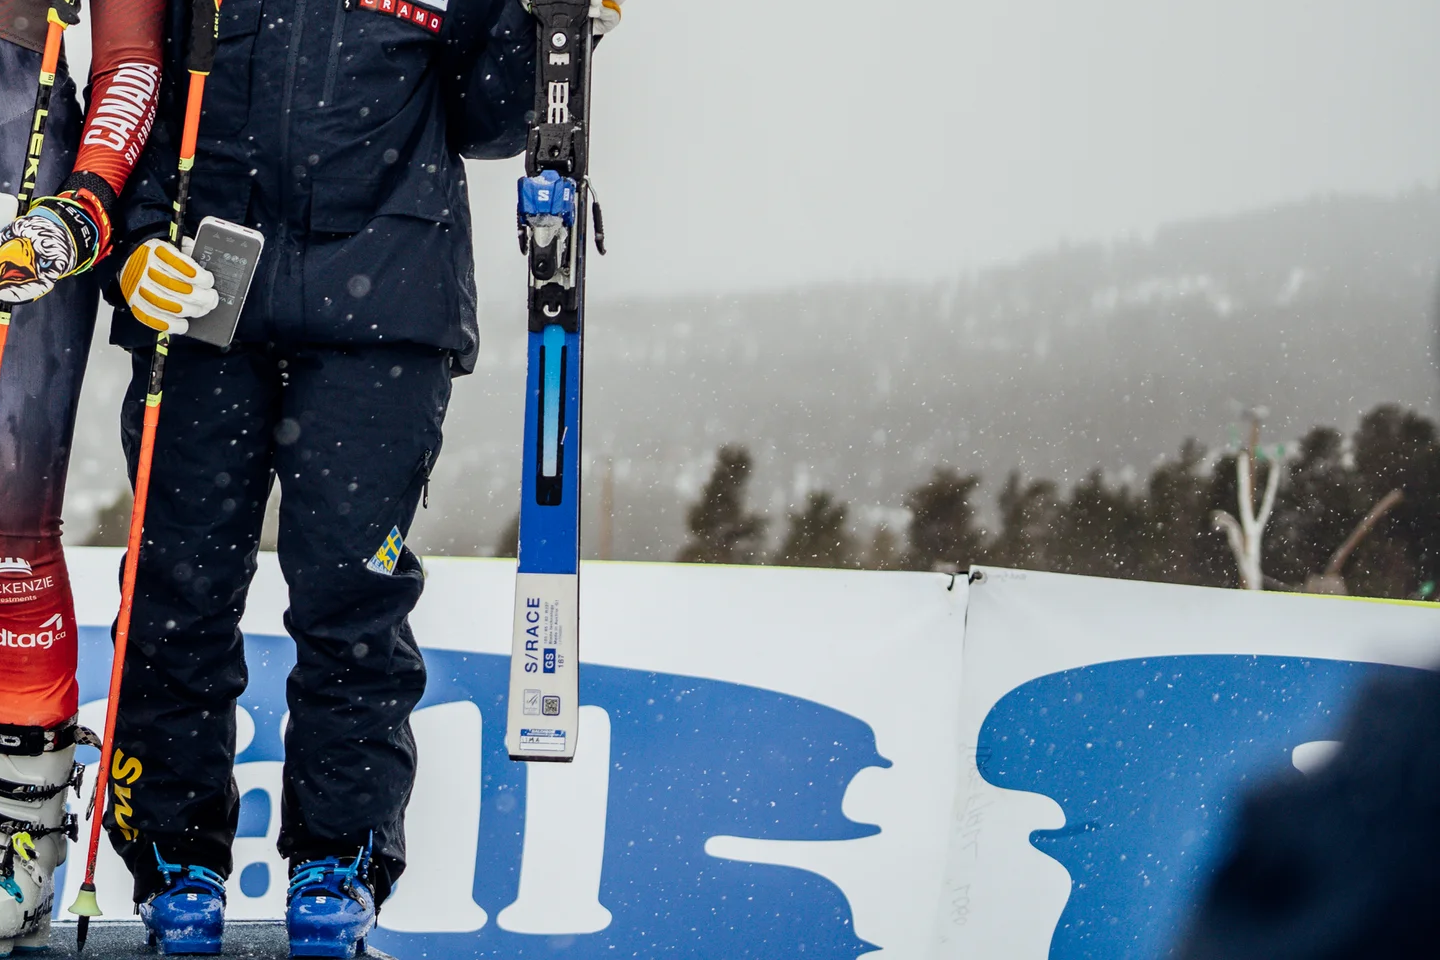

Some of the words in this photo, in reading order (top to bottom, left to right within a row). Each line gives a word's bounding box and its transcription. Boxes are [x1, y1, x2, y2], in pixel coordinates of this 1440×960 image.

[83, 62, 159, 152] CANADA
[124, 141, 140, 166] SKI
[137, 105, 156, 146] CROSS
[57, 201, 92, 248] LEVEL
[524, 597, 540, 673] S/RACE
[545, 653, 554, 669] GS
